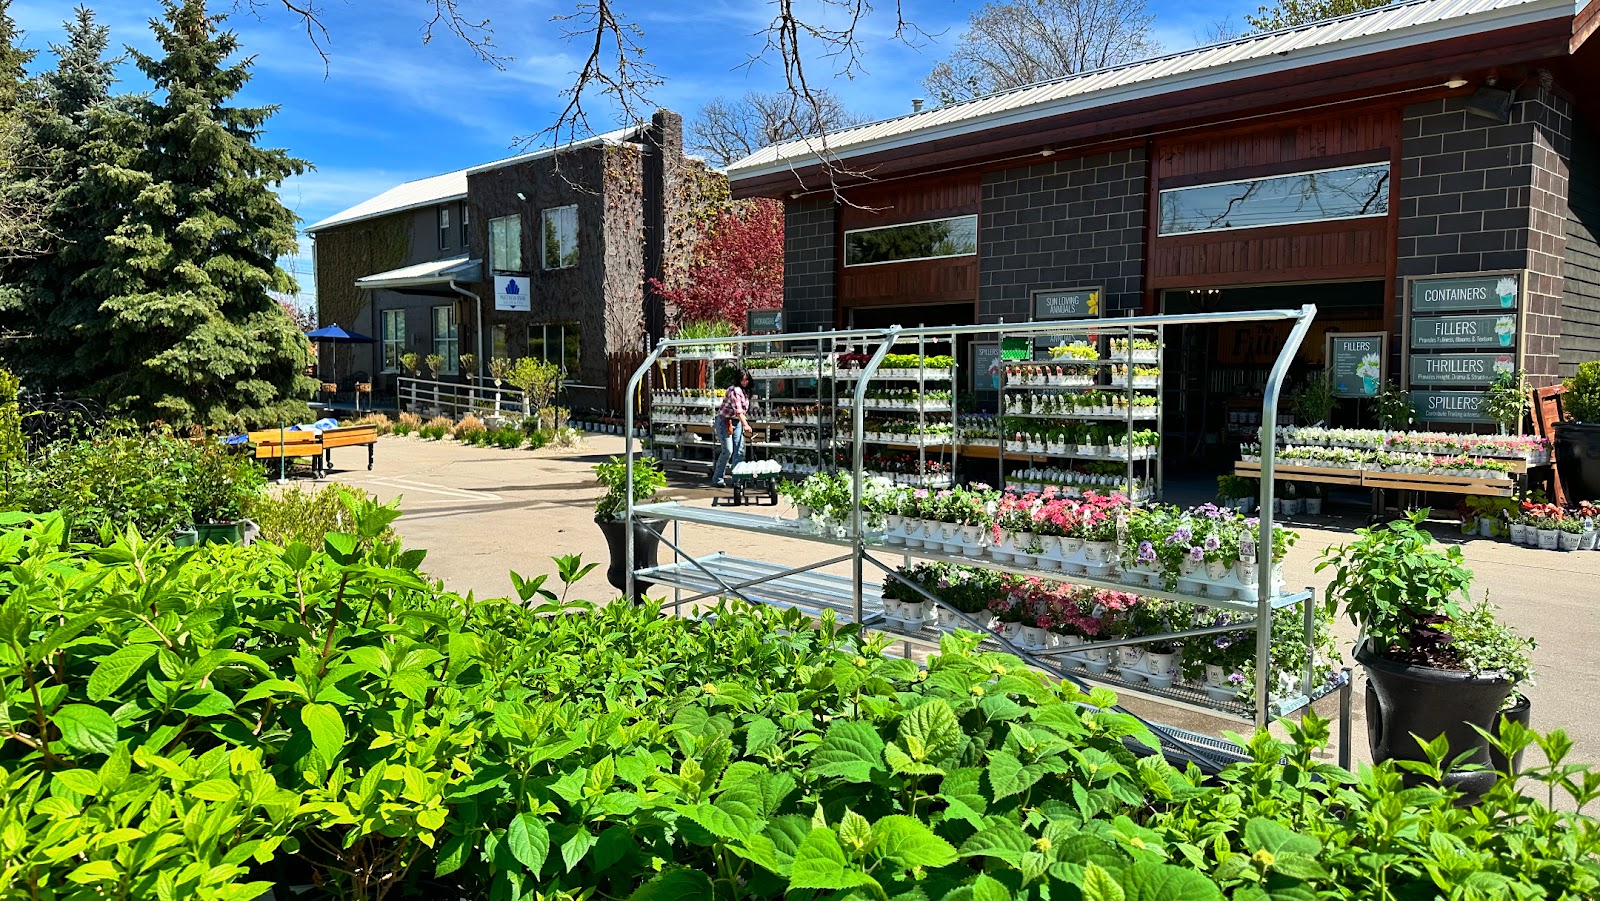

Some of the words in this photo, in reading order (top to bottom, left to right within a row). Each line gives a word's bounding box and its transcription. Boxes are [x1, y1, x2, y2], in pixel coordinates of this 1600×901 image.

[1424, 287, 1487, 302] CONTAINERS
[1046, 297, 1058, 306] SUN
[1058, 296, 1080, 306] LOVING
[1049, 304, 1076, 314] ANNUALS
[1435, 321, 1477, 335] FILLERS
[1343, 341, 1371, 351] FILLERS
[978, 348, 999, 356] SPILLERS
[1426, 359, 1484, 372] THRILLERS
[1428, 396, 1478, 410] SPILLERS
